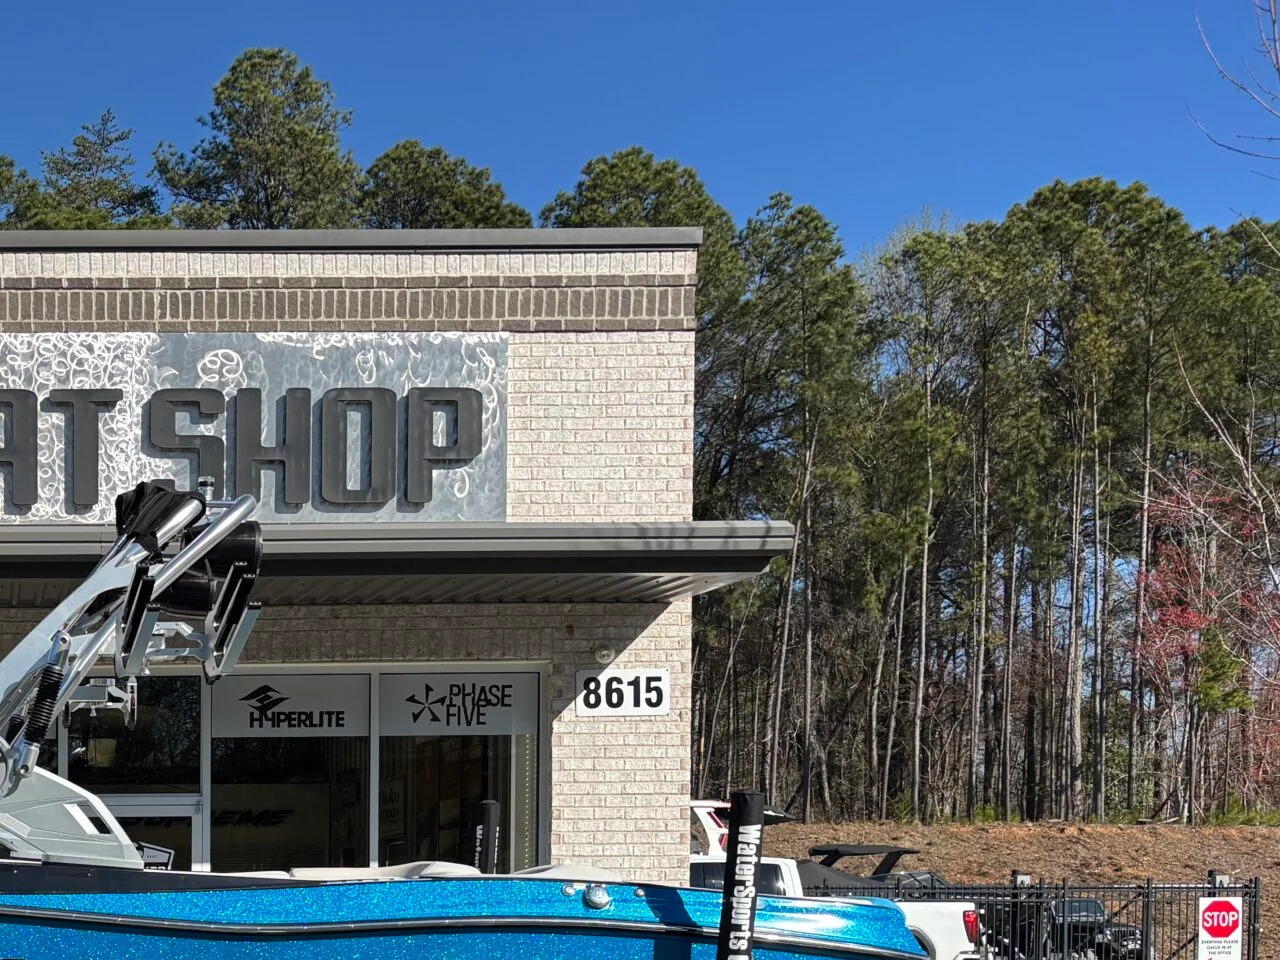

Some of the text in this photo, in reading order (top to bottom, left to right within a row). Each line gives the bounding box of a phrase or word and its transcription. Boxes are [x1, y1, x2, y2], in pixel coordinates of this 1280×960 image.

[150, 387, 483, 504] SHOP
[449, 683, 512, 708] PHASE
[583, 676, 663, 709] 8615
[249, 710, 345, 728] HYPERLITE
[446, 703, 486, 726] FIVE
[729, 824, 761, 951] WaterSports
[1203, 911, 1238, 927] STOP
